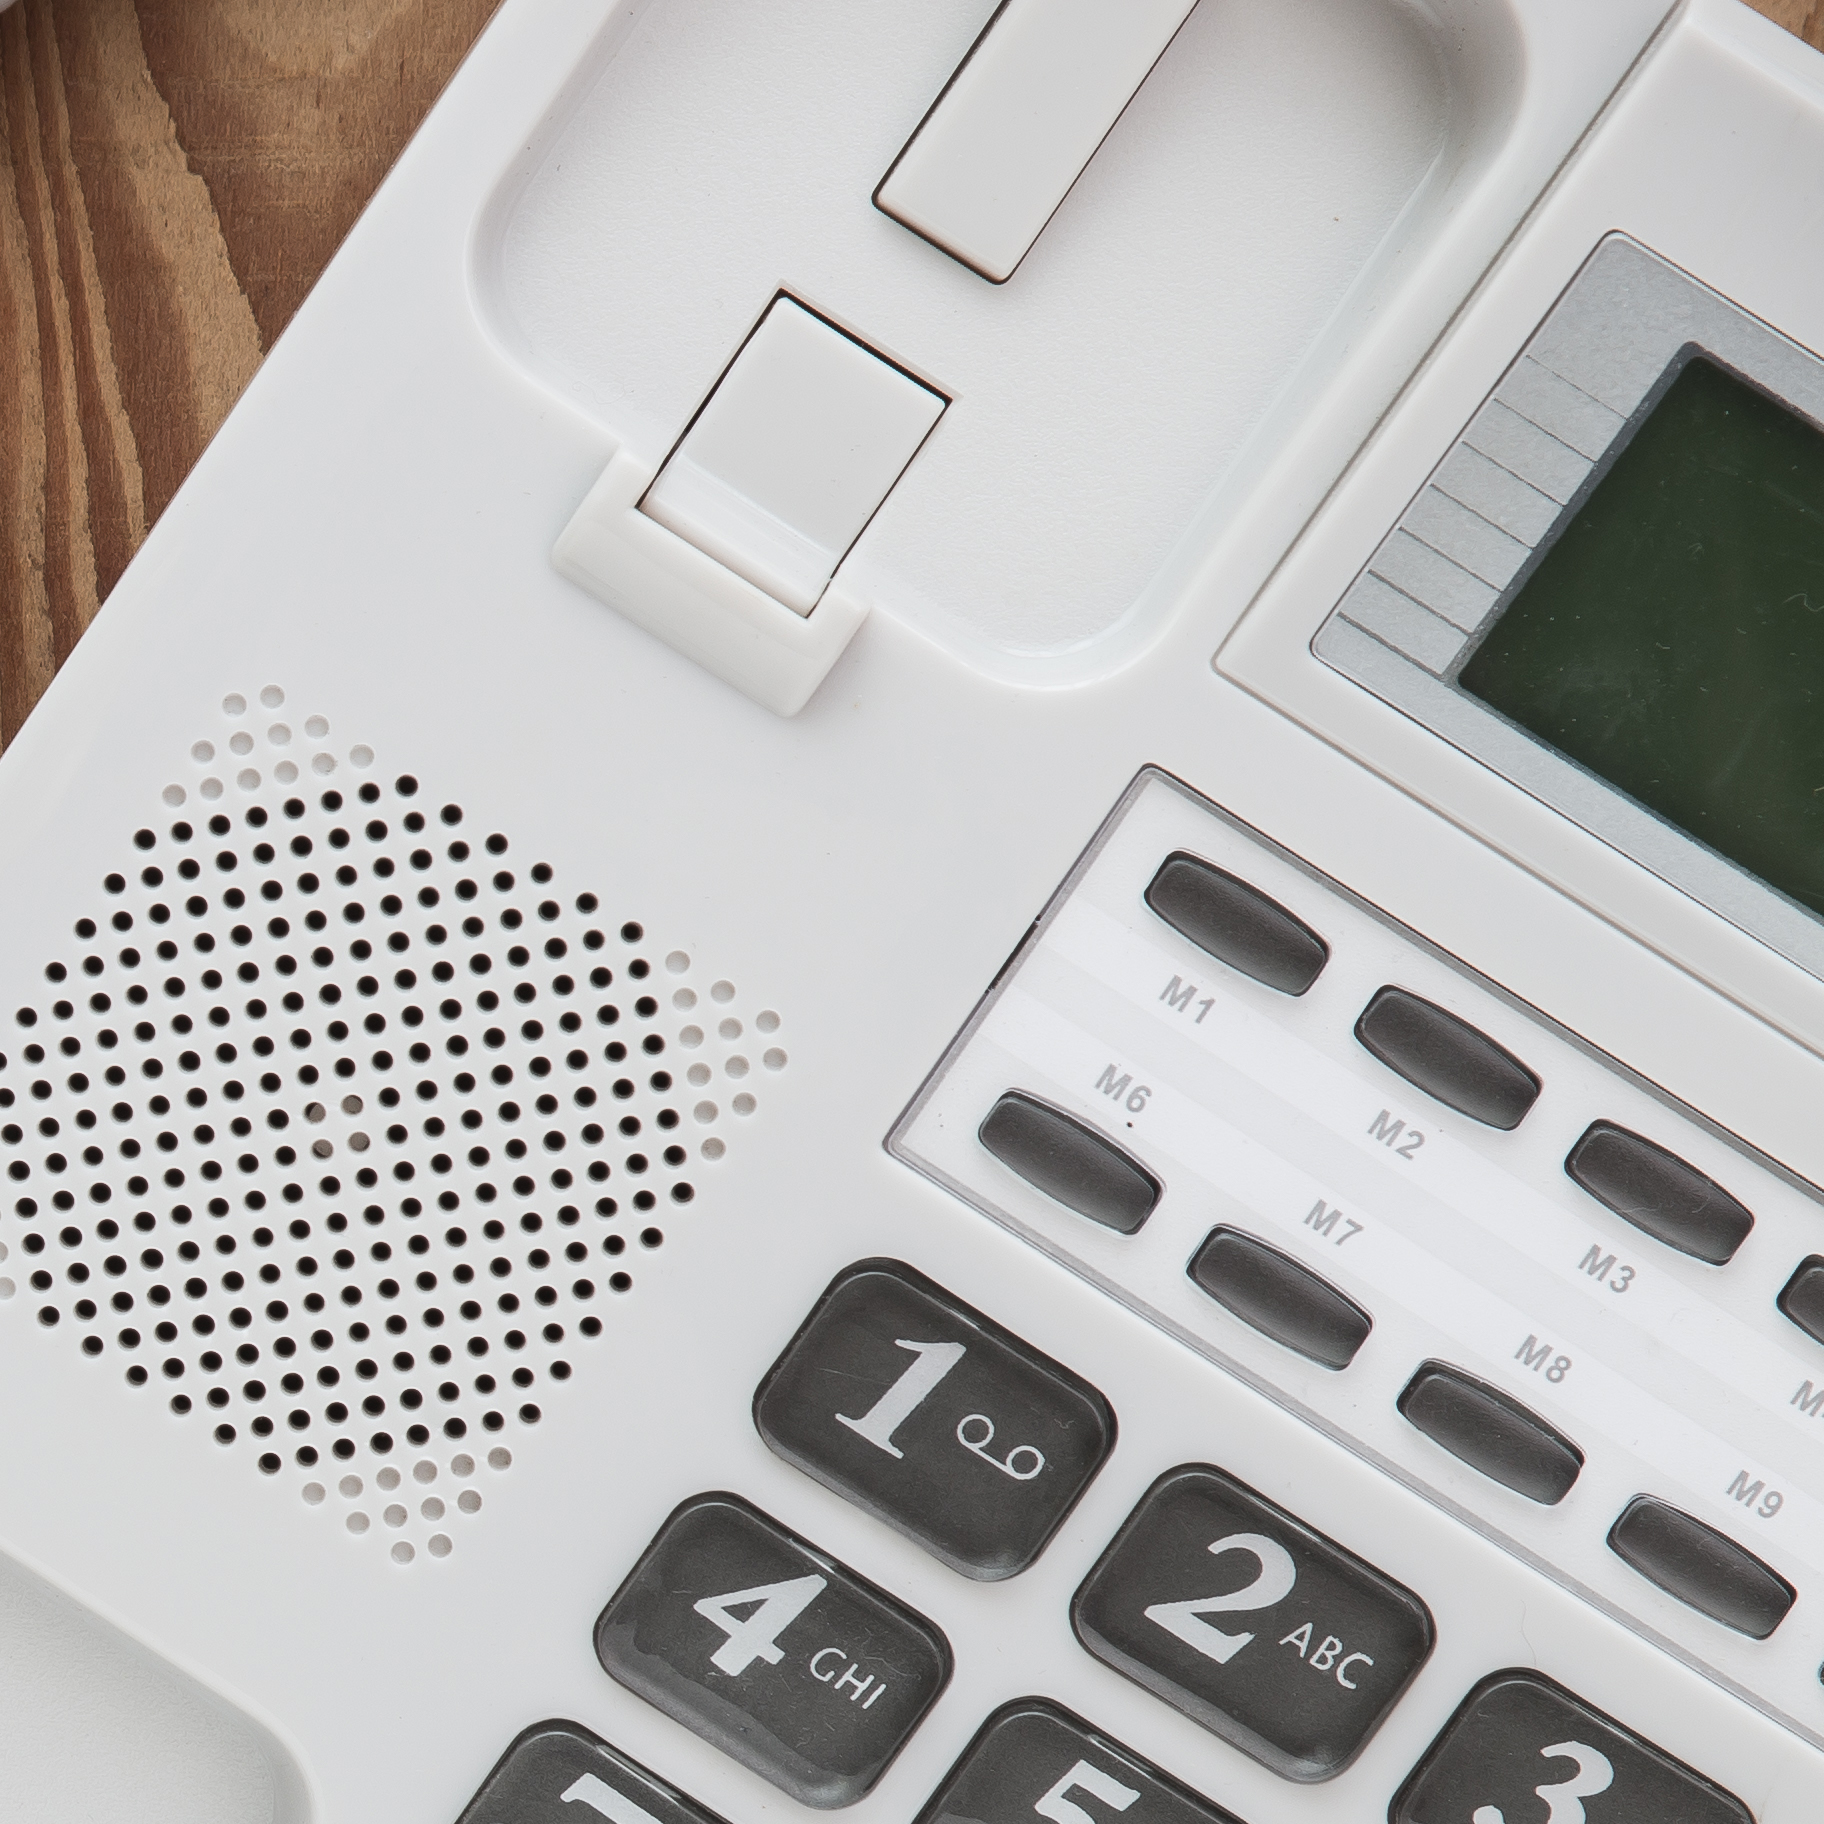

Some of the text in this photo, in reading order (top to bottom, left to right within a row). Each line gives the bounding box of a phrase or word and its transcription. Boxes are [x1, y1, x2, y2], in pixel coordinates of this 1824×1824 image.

[1159, 974, 1216, 1025] M1
[1094, 1063, 1152, 1114] M6
[1367, 1108, 1426, 1161] M2
[1303, 1199, 1364, 1246] M7
[1577, 1243, 1636, 1294] M3
[1513, 1334, 1572, 1384] M8
[834, 1338, 967, 1459] 1
[1790, 1379, 1824, 1418] M
[1725, 1469, 1784, 1519] M9
[1143, 1532, 1374, 1690] 2 ABC
[693, 1573, 887, 1710] 4 GHI
